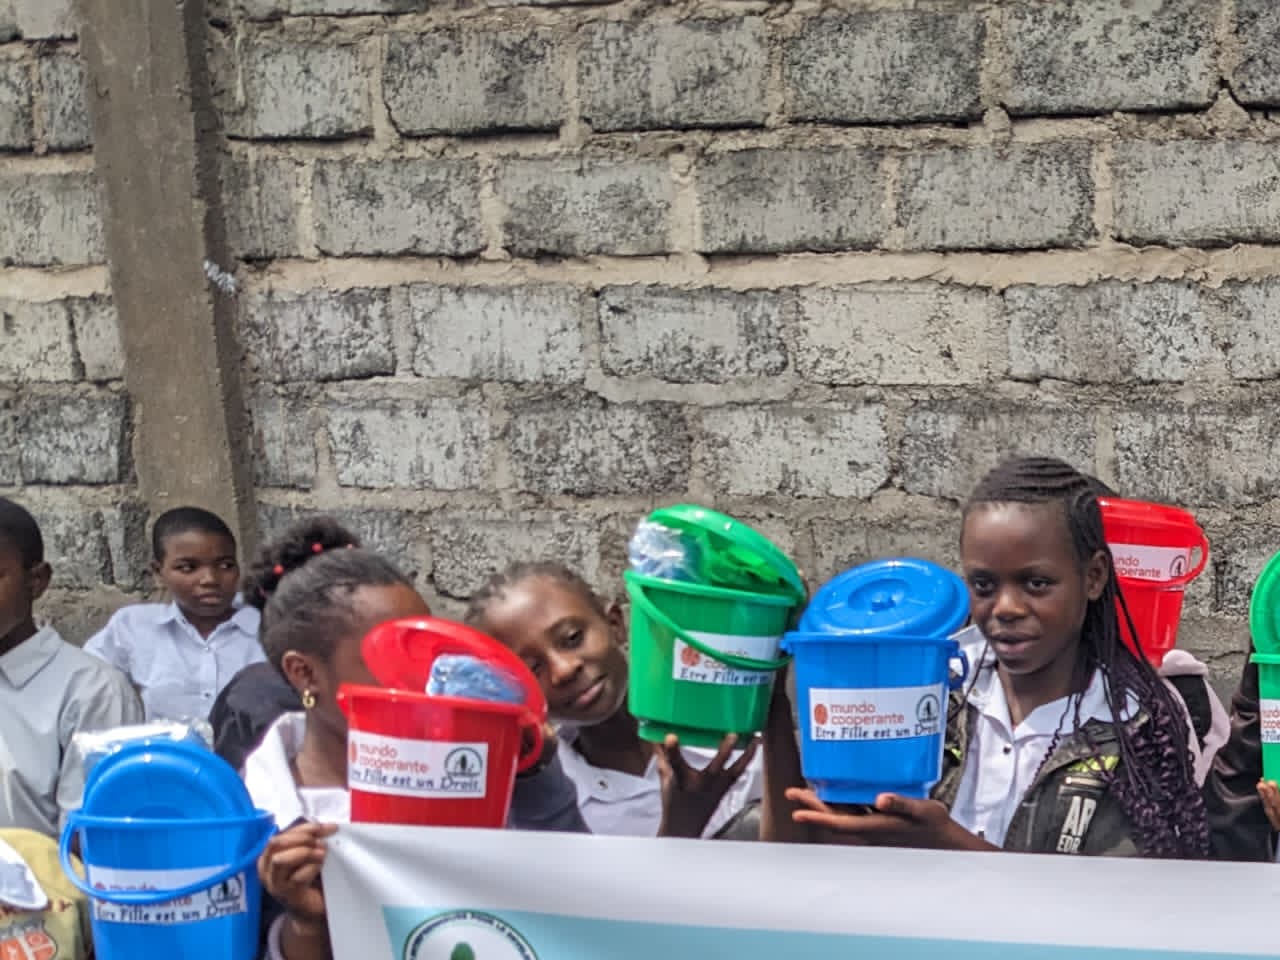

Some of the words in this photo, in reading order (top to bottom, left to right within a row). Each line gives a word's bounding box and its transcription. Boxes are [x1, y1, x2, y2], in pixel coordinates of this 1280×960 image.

[680, 667, 708, 680] Etre
[830, 701, 876, 713] mundo
[831, 713, 905, 727] cooperante
[841, 725, 869, 739] Fille
[873, 728, 891, 737] est
